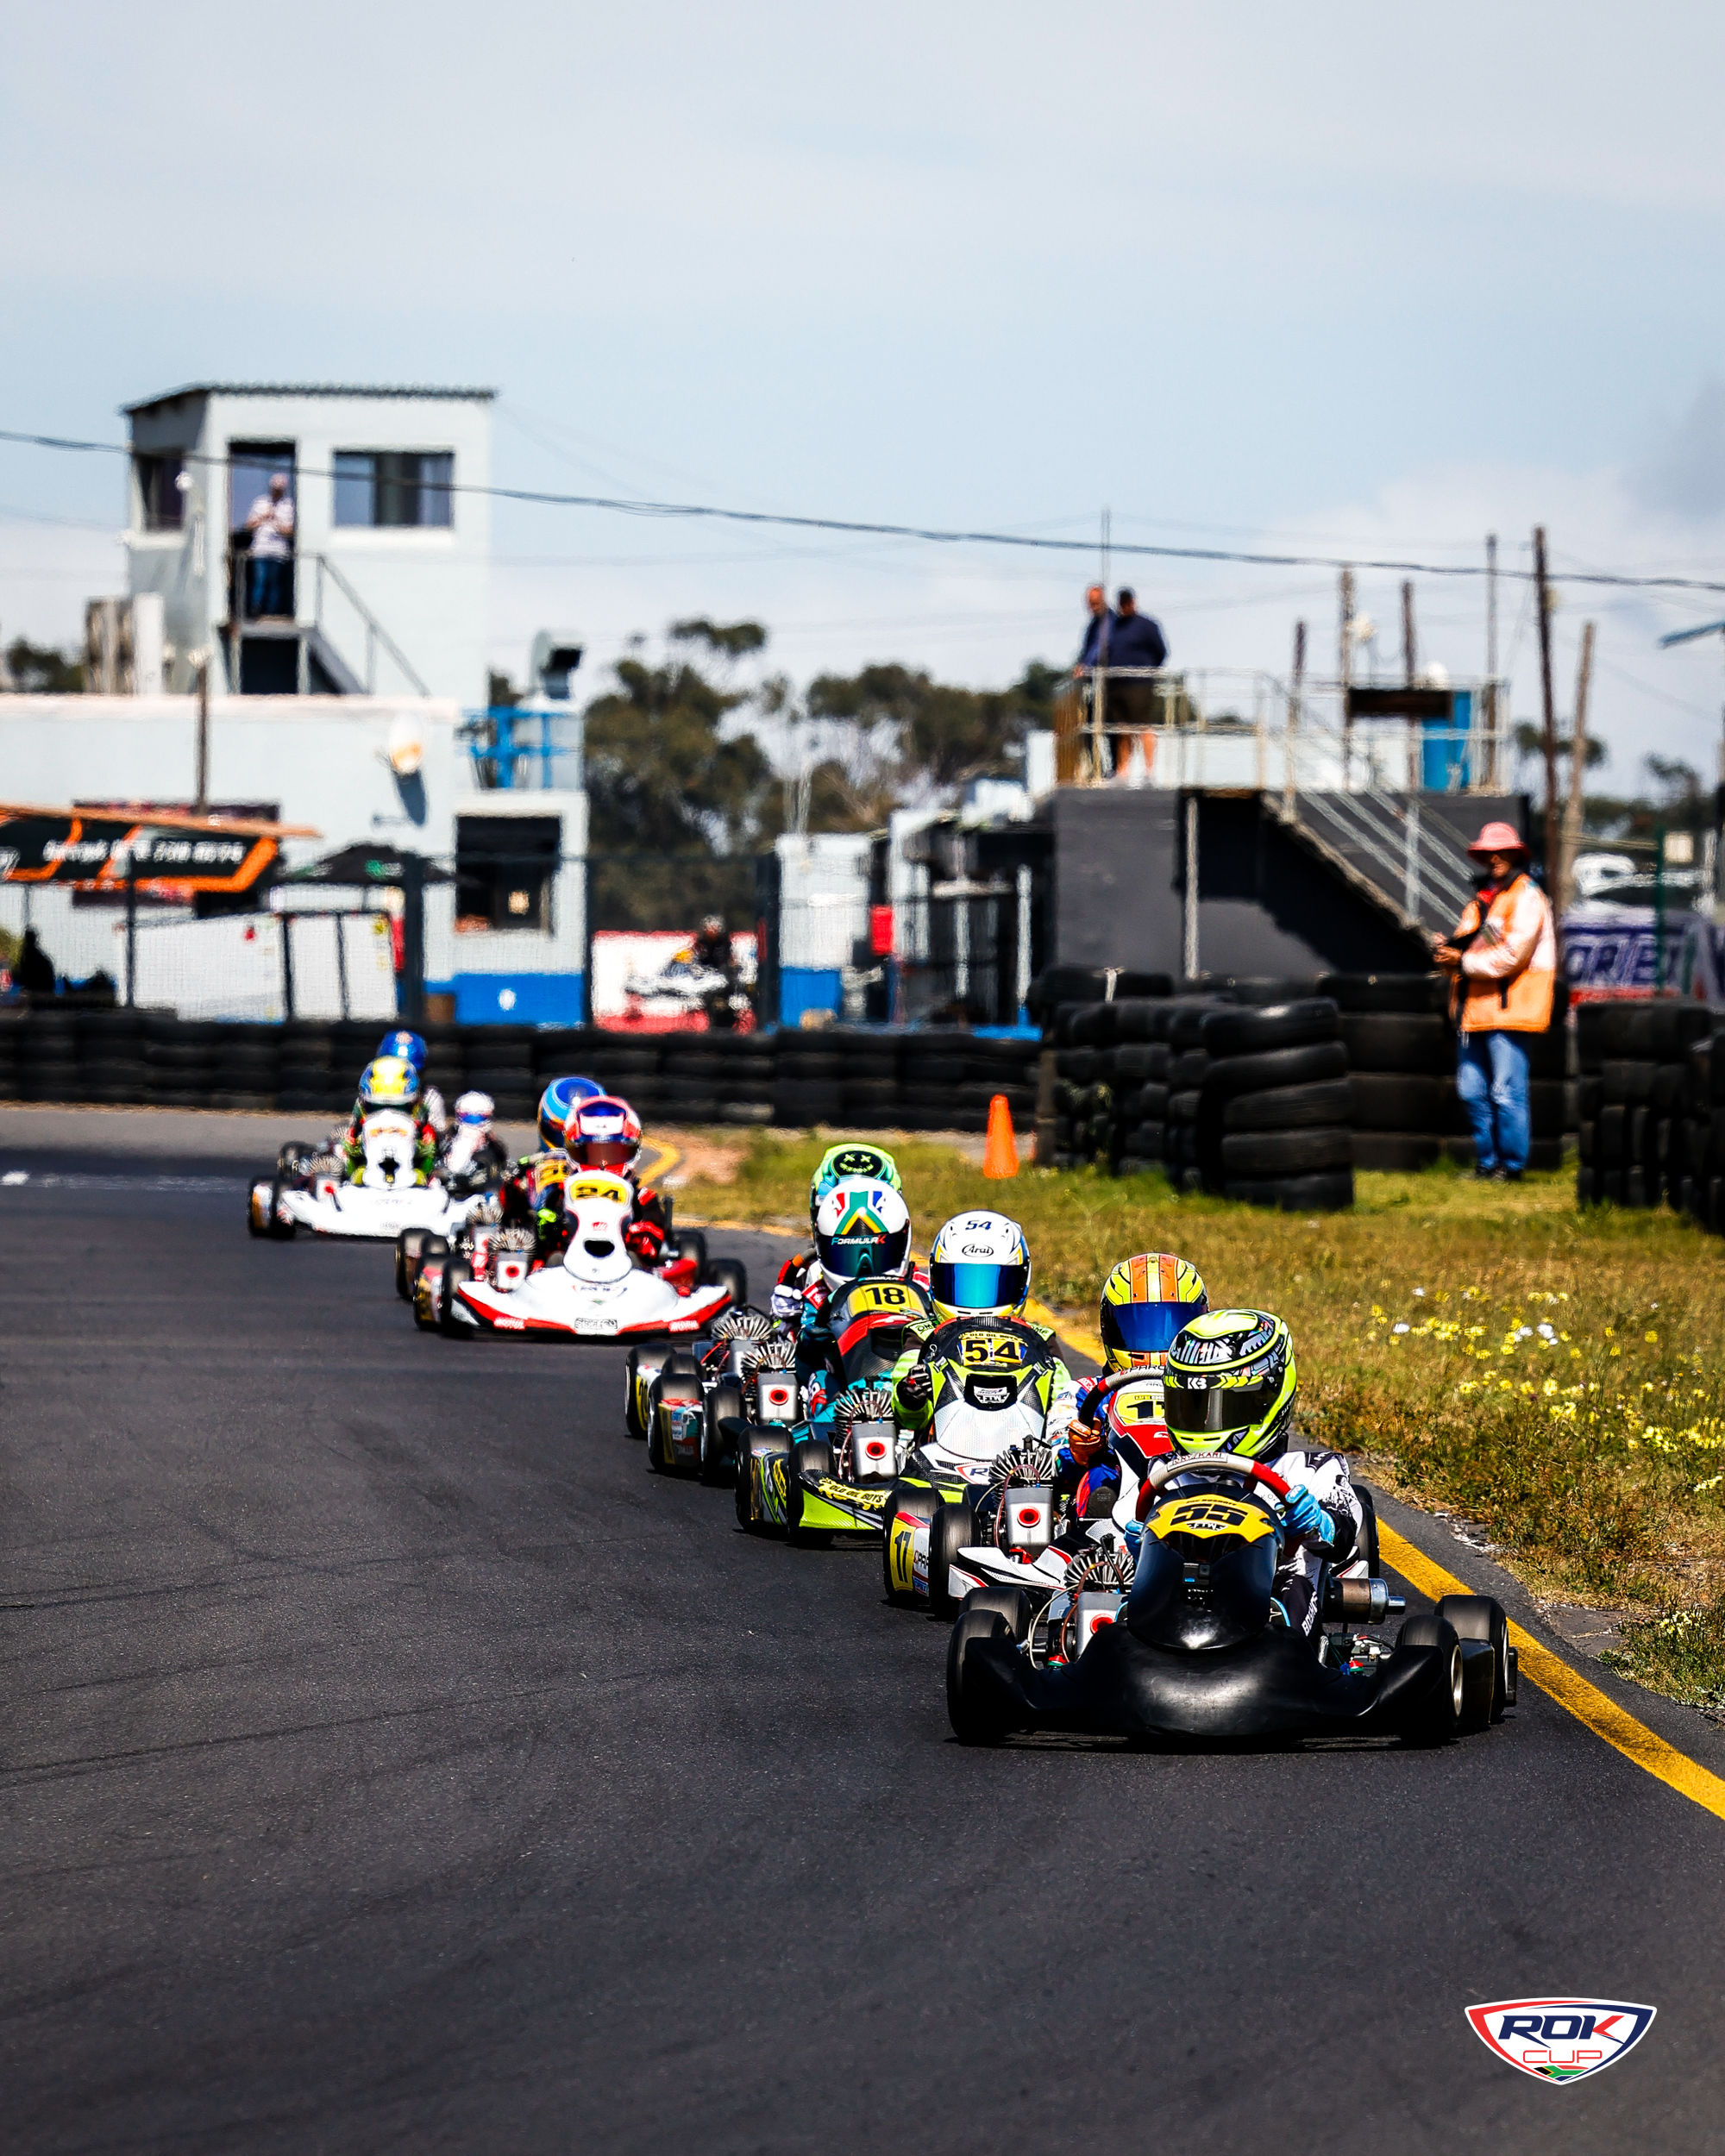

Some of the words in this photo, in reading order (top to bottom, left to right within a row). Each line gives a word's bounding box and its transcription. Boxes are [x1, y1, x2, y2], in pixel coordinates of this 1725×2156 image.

[965, 1220, 992, 1231] 54
[969, 1245, 991, 1254] Arai
[865, 1288, 906, 1305] 18
[965, 1339, 1019, 1363] 54
[829, 1483, 844, 1494] OLD
[846, 1489, 859, 1499] OIL
[861, 1493, 885, 1503] BOYS
[1170, 1503, 1249, 1526] 55
[894, 1531, 912, 1583] 17
